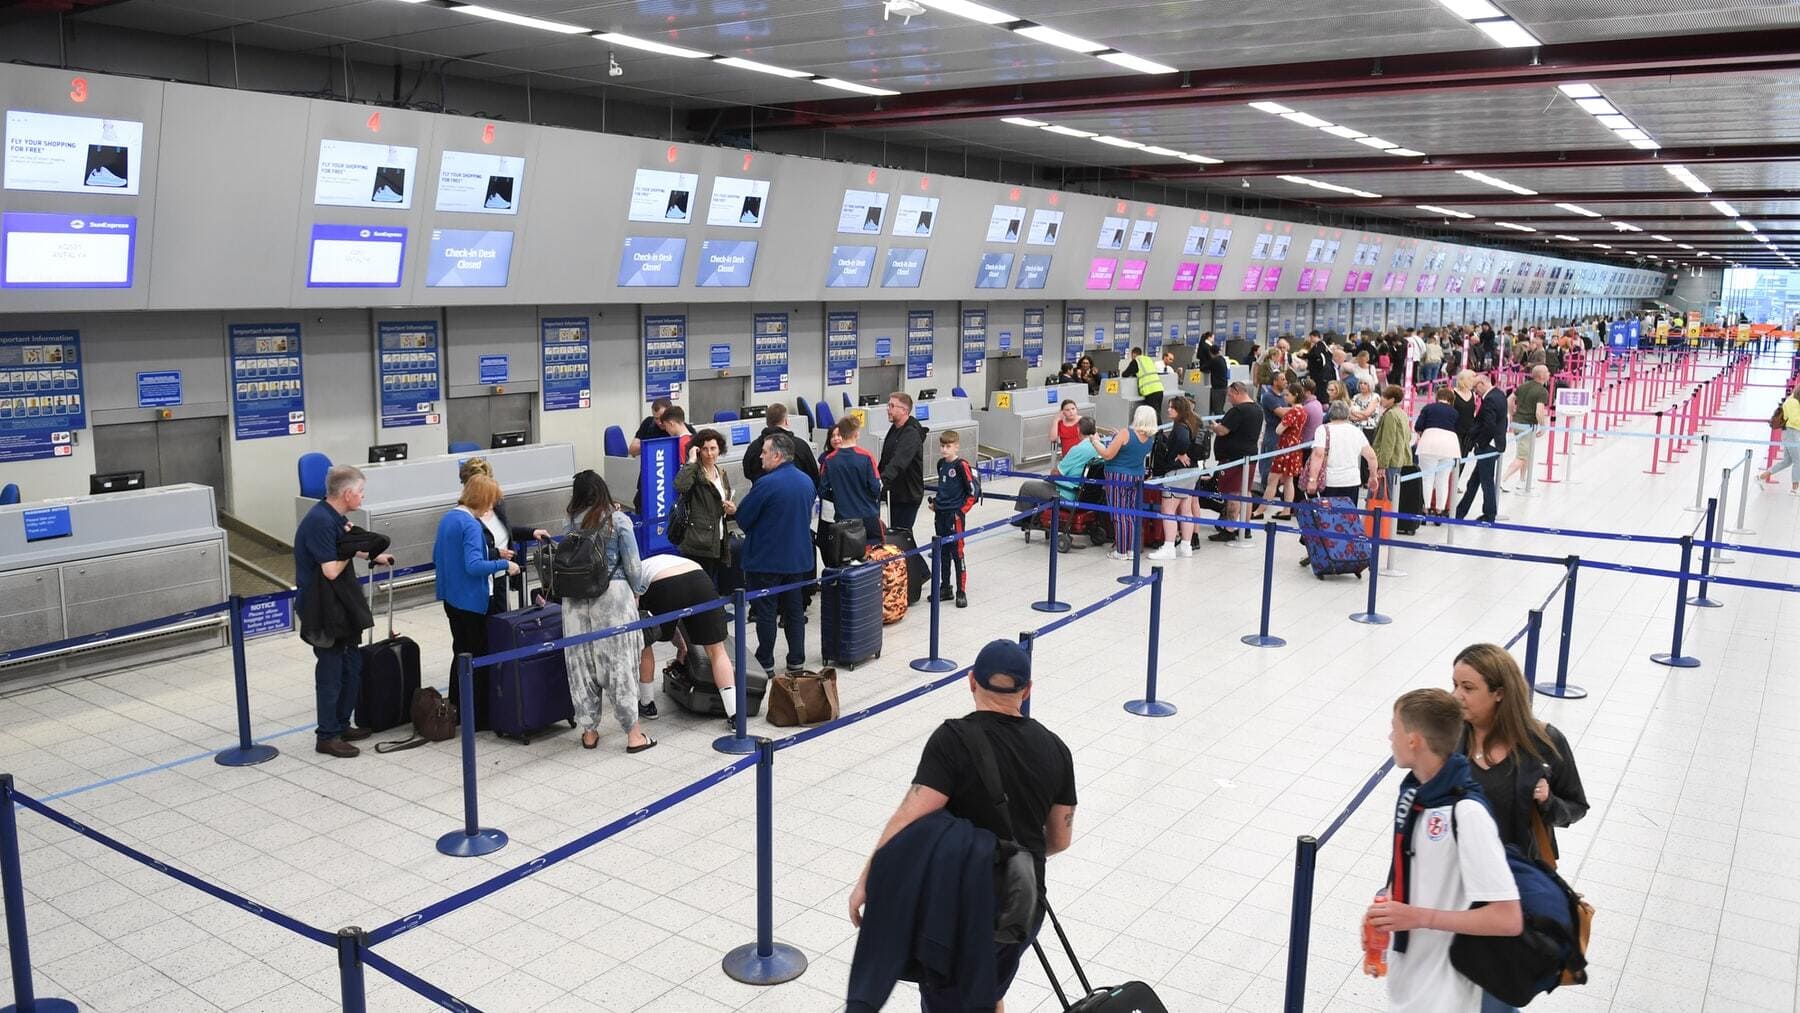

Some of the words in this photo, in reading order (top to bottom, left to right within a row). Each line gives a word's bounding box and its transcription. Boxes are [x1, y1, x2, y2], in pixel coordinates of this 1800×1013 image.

[70, 77, 87, 102] 3
[366, 111, 381, 132] 4
[43, 140, 76, 148] SHOPPING
[482, 123, 495, 144] 5
[744, 154, 752, 171] 7
[656, 449, 665, 524] RYANAIR
[251, 601, 276, 611] NOTICE
